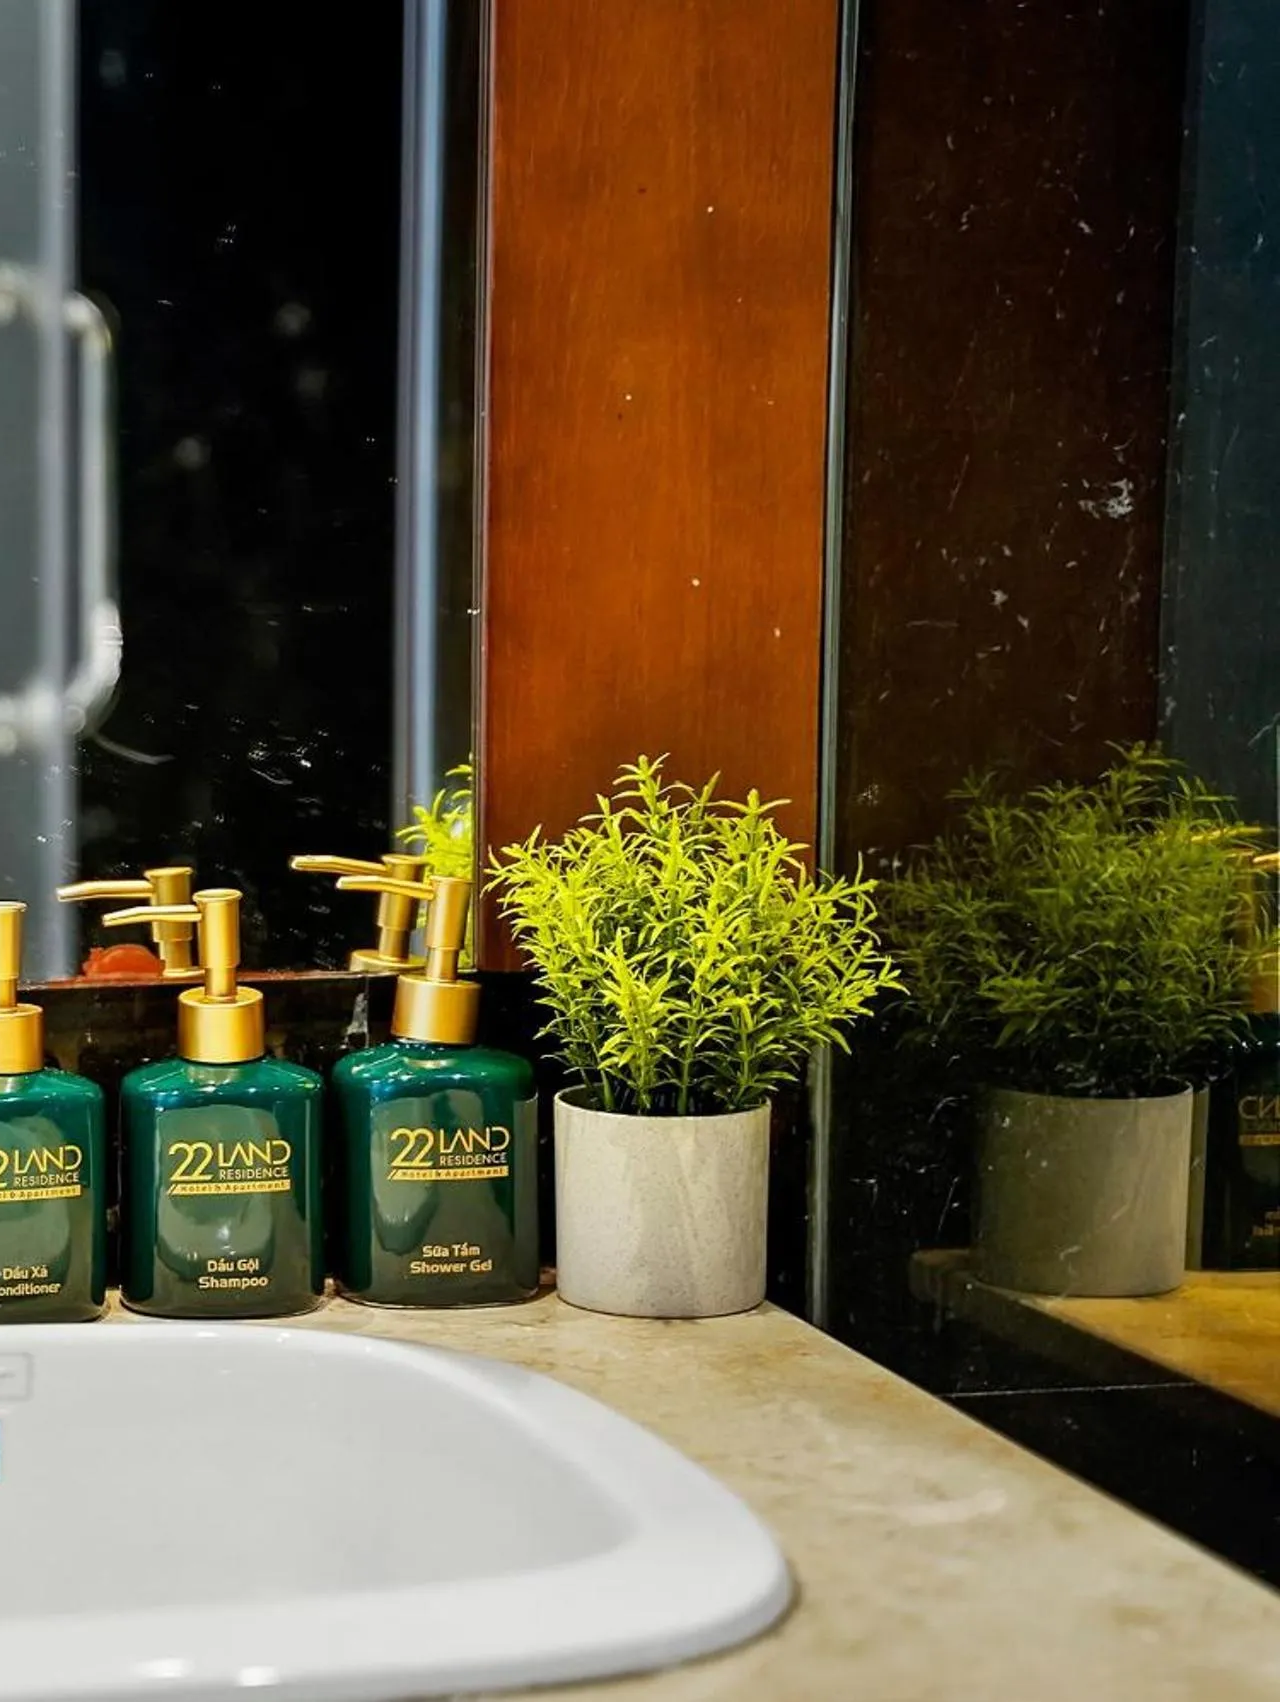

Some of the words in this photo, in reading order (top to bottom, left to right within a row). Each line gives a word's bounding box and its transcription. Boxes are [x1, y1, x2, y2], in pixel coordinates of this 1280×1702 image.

[390, 1128, 435, 1167] 22
[440, 1126, 510, 1153] LAND
[14, 1145, 83, 1174] LAND
[168, 1142, 215, 1181] 22
[218, 1140, 291, 1167] LAND
[440, 1152, 508, 1166] RESIDENCE
[13, 1171, 80, 1187] RESIDENCE
[219, 1166, 289, 1180] RESIDENCE
[410, 1261, 467, 1274] Shower
[469, 1259, 493, 1271] Gel
[198, 1276, 269, 1290] Shampoo
